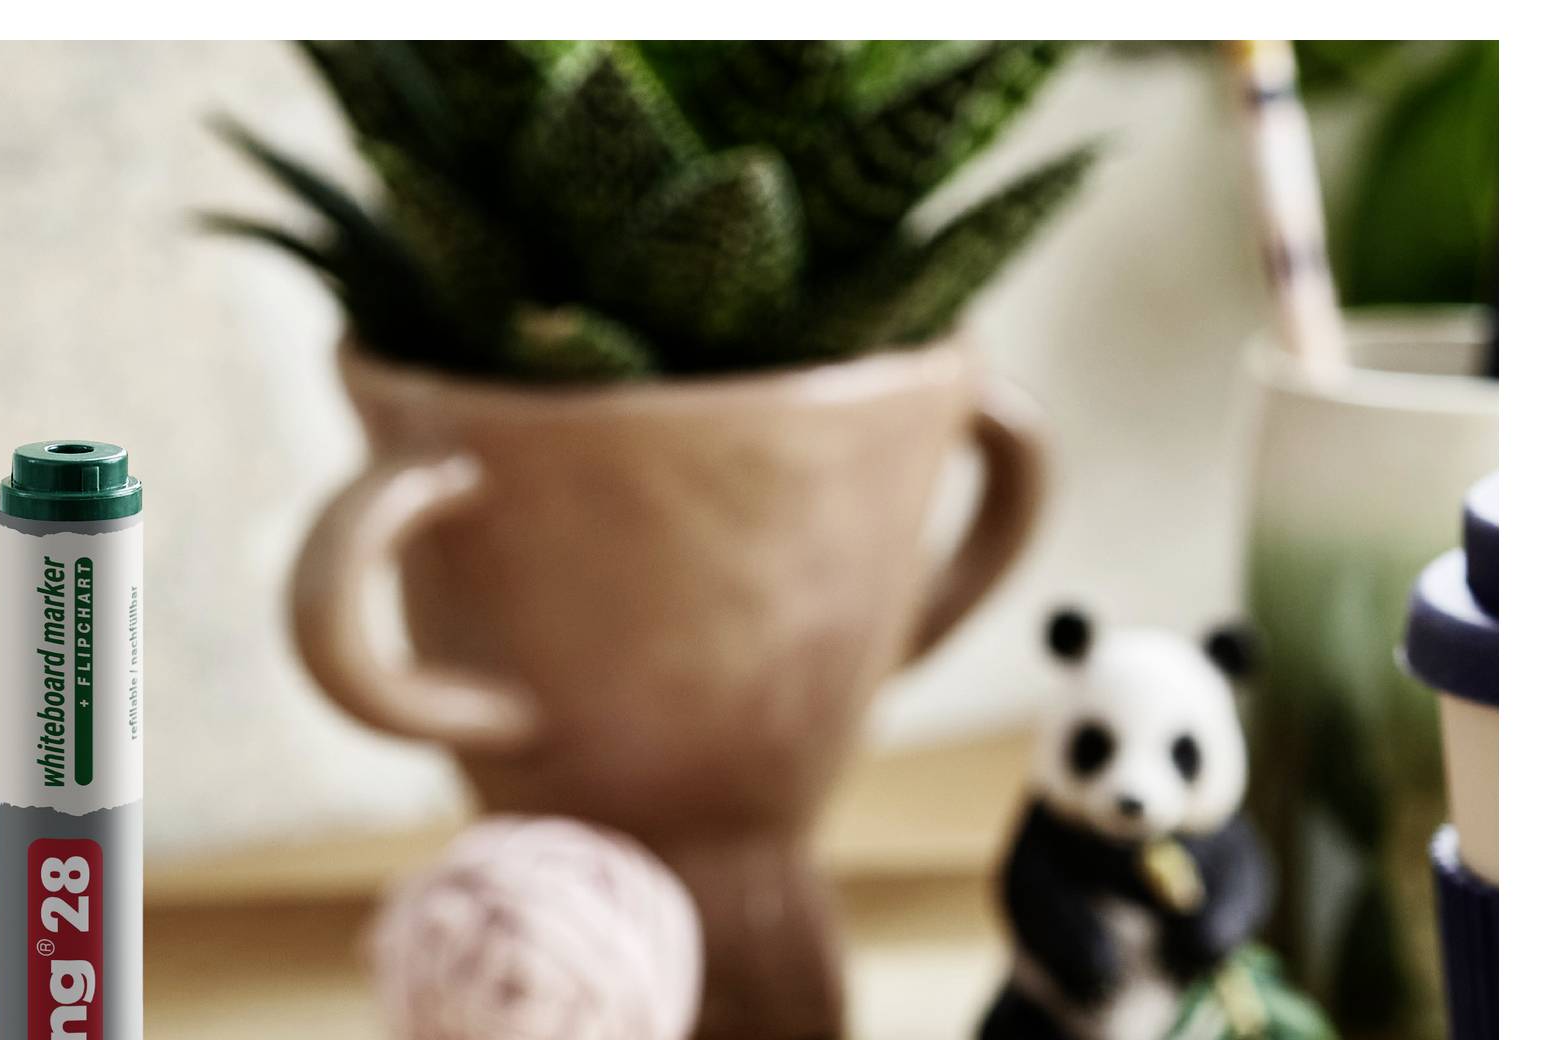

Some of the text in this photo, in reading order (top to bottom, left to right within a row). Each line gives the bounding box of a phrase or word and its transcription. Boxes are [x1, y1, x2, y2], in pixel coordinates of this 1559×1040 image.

[77, 563, 91, 686] FLIPCHART
[128, 586, 138, 665] nachfüllbar
[36, 556, 65, 787] whiteboard marker
[128, 677, 138, 740] refillable
[40, 856, 91, 933] 28
